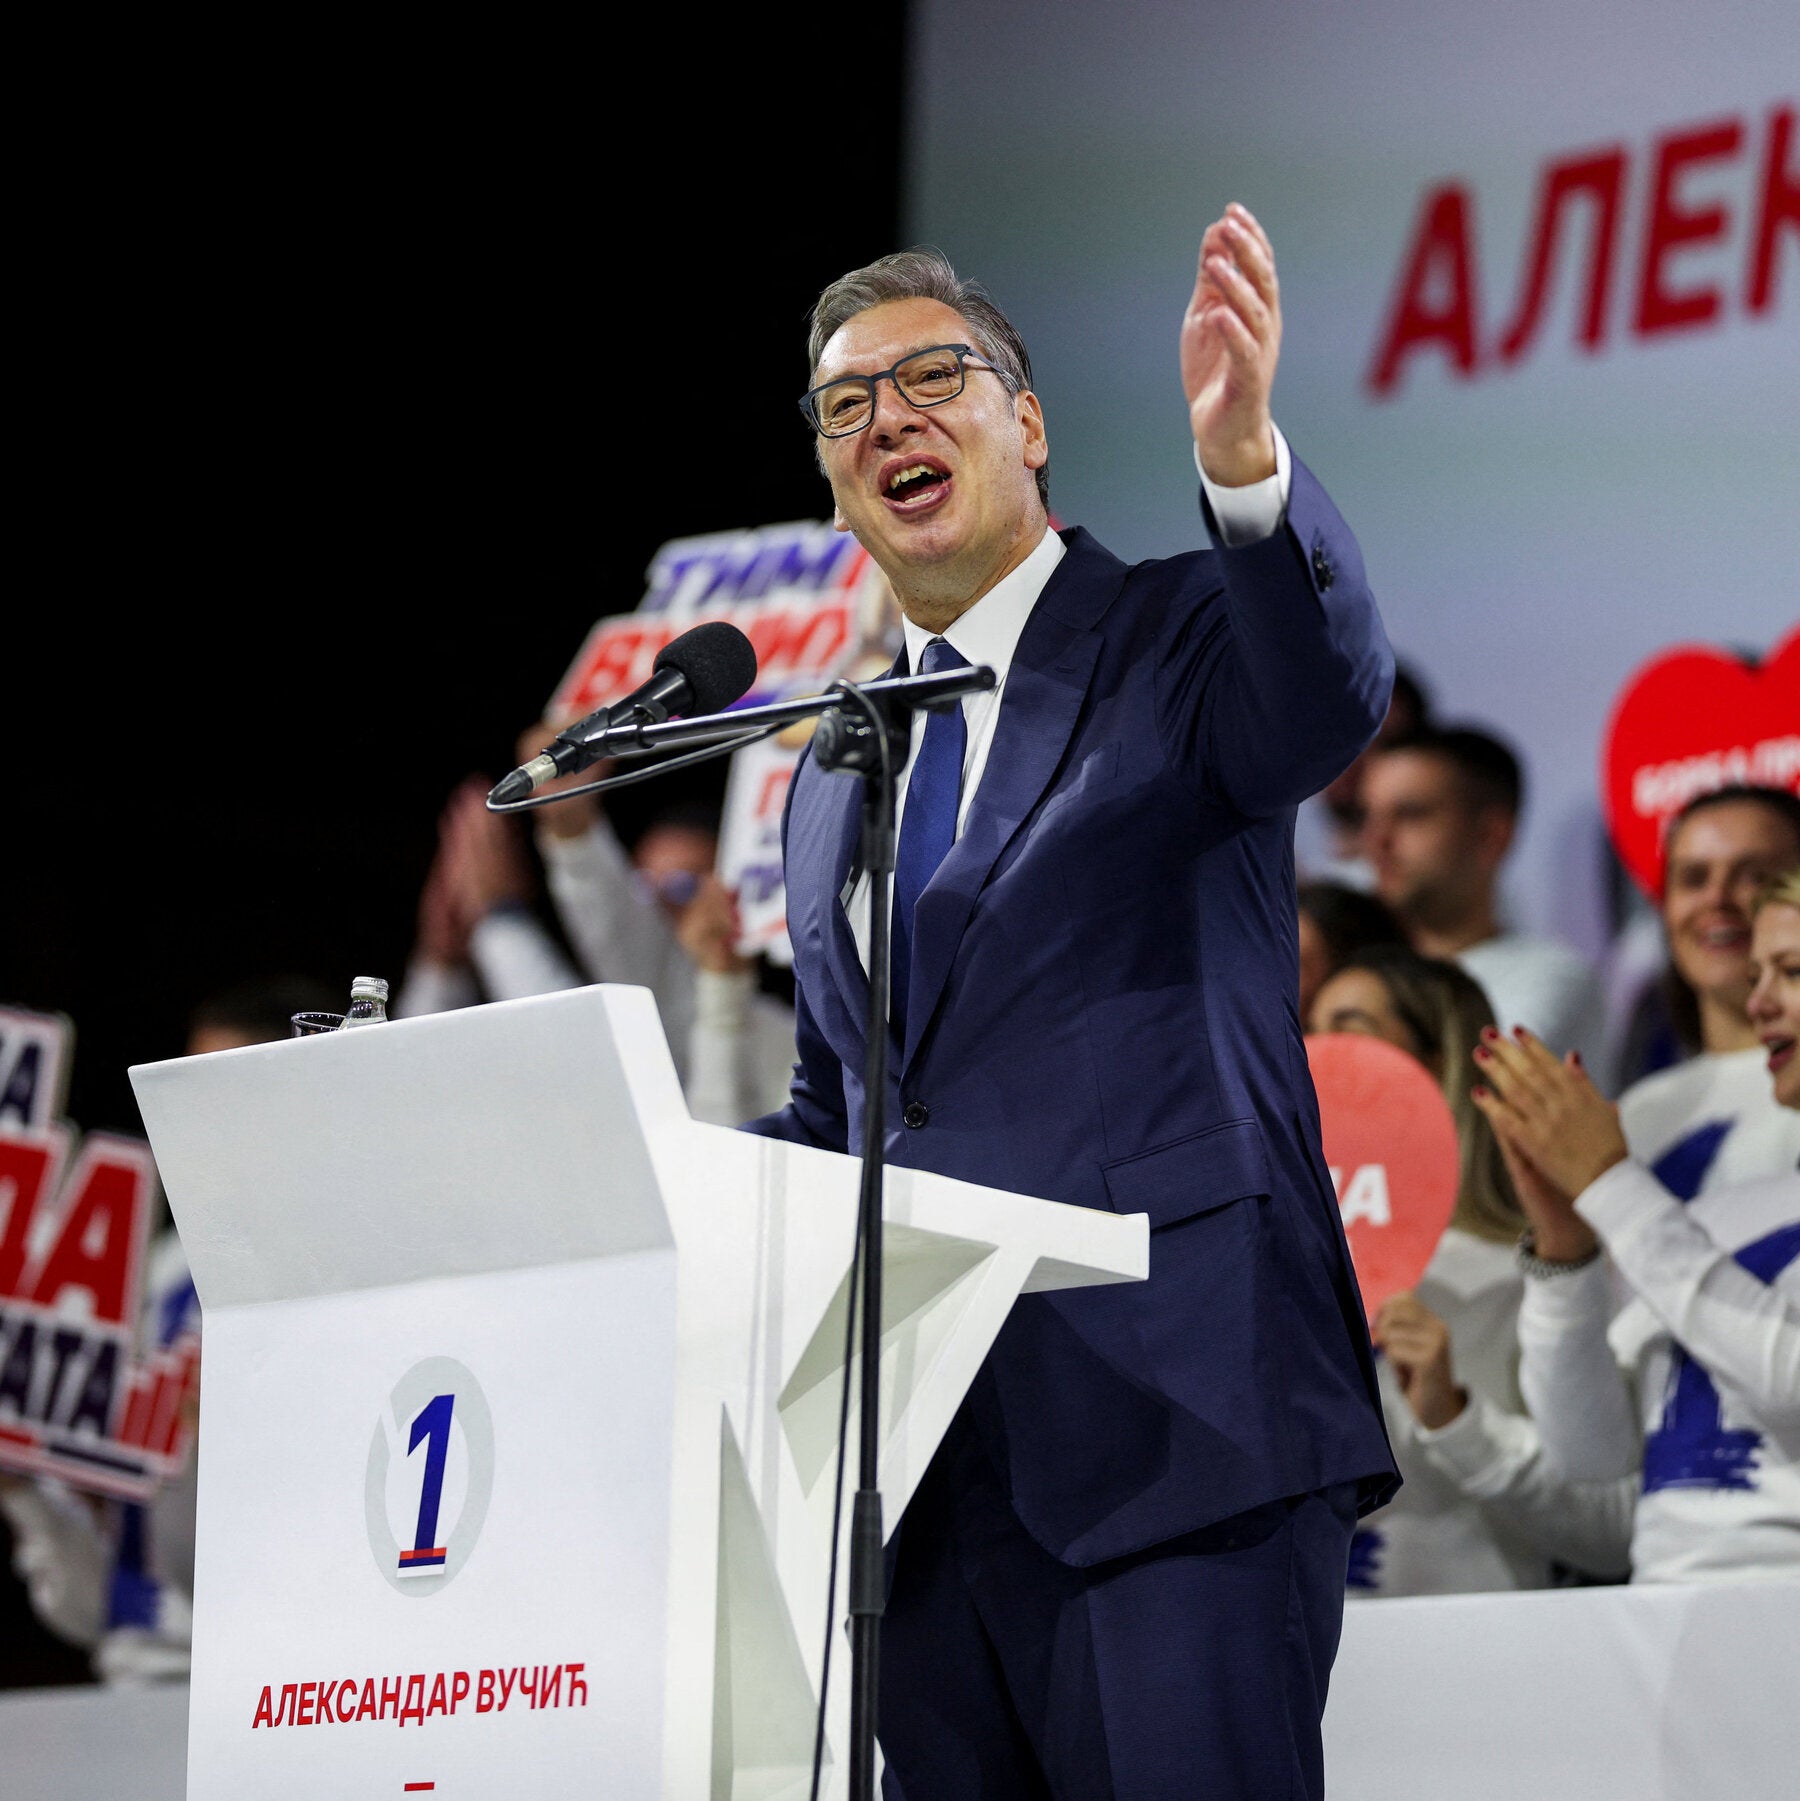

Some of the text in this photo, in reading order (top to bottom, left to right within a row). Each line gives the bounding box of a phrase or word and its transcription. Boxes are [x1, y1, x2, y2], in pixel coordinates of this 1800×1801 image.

[396, 1393, 455, 1578] 1
[251, 1662, 588, 1729] АЛЕКСАНДАР ВУЧИЋ
